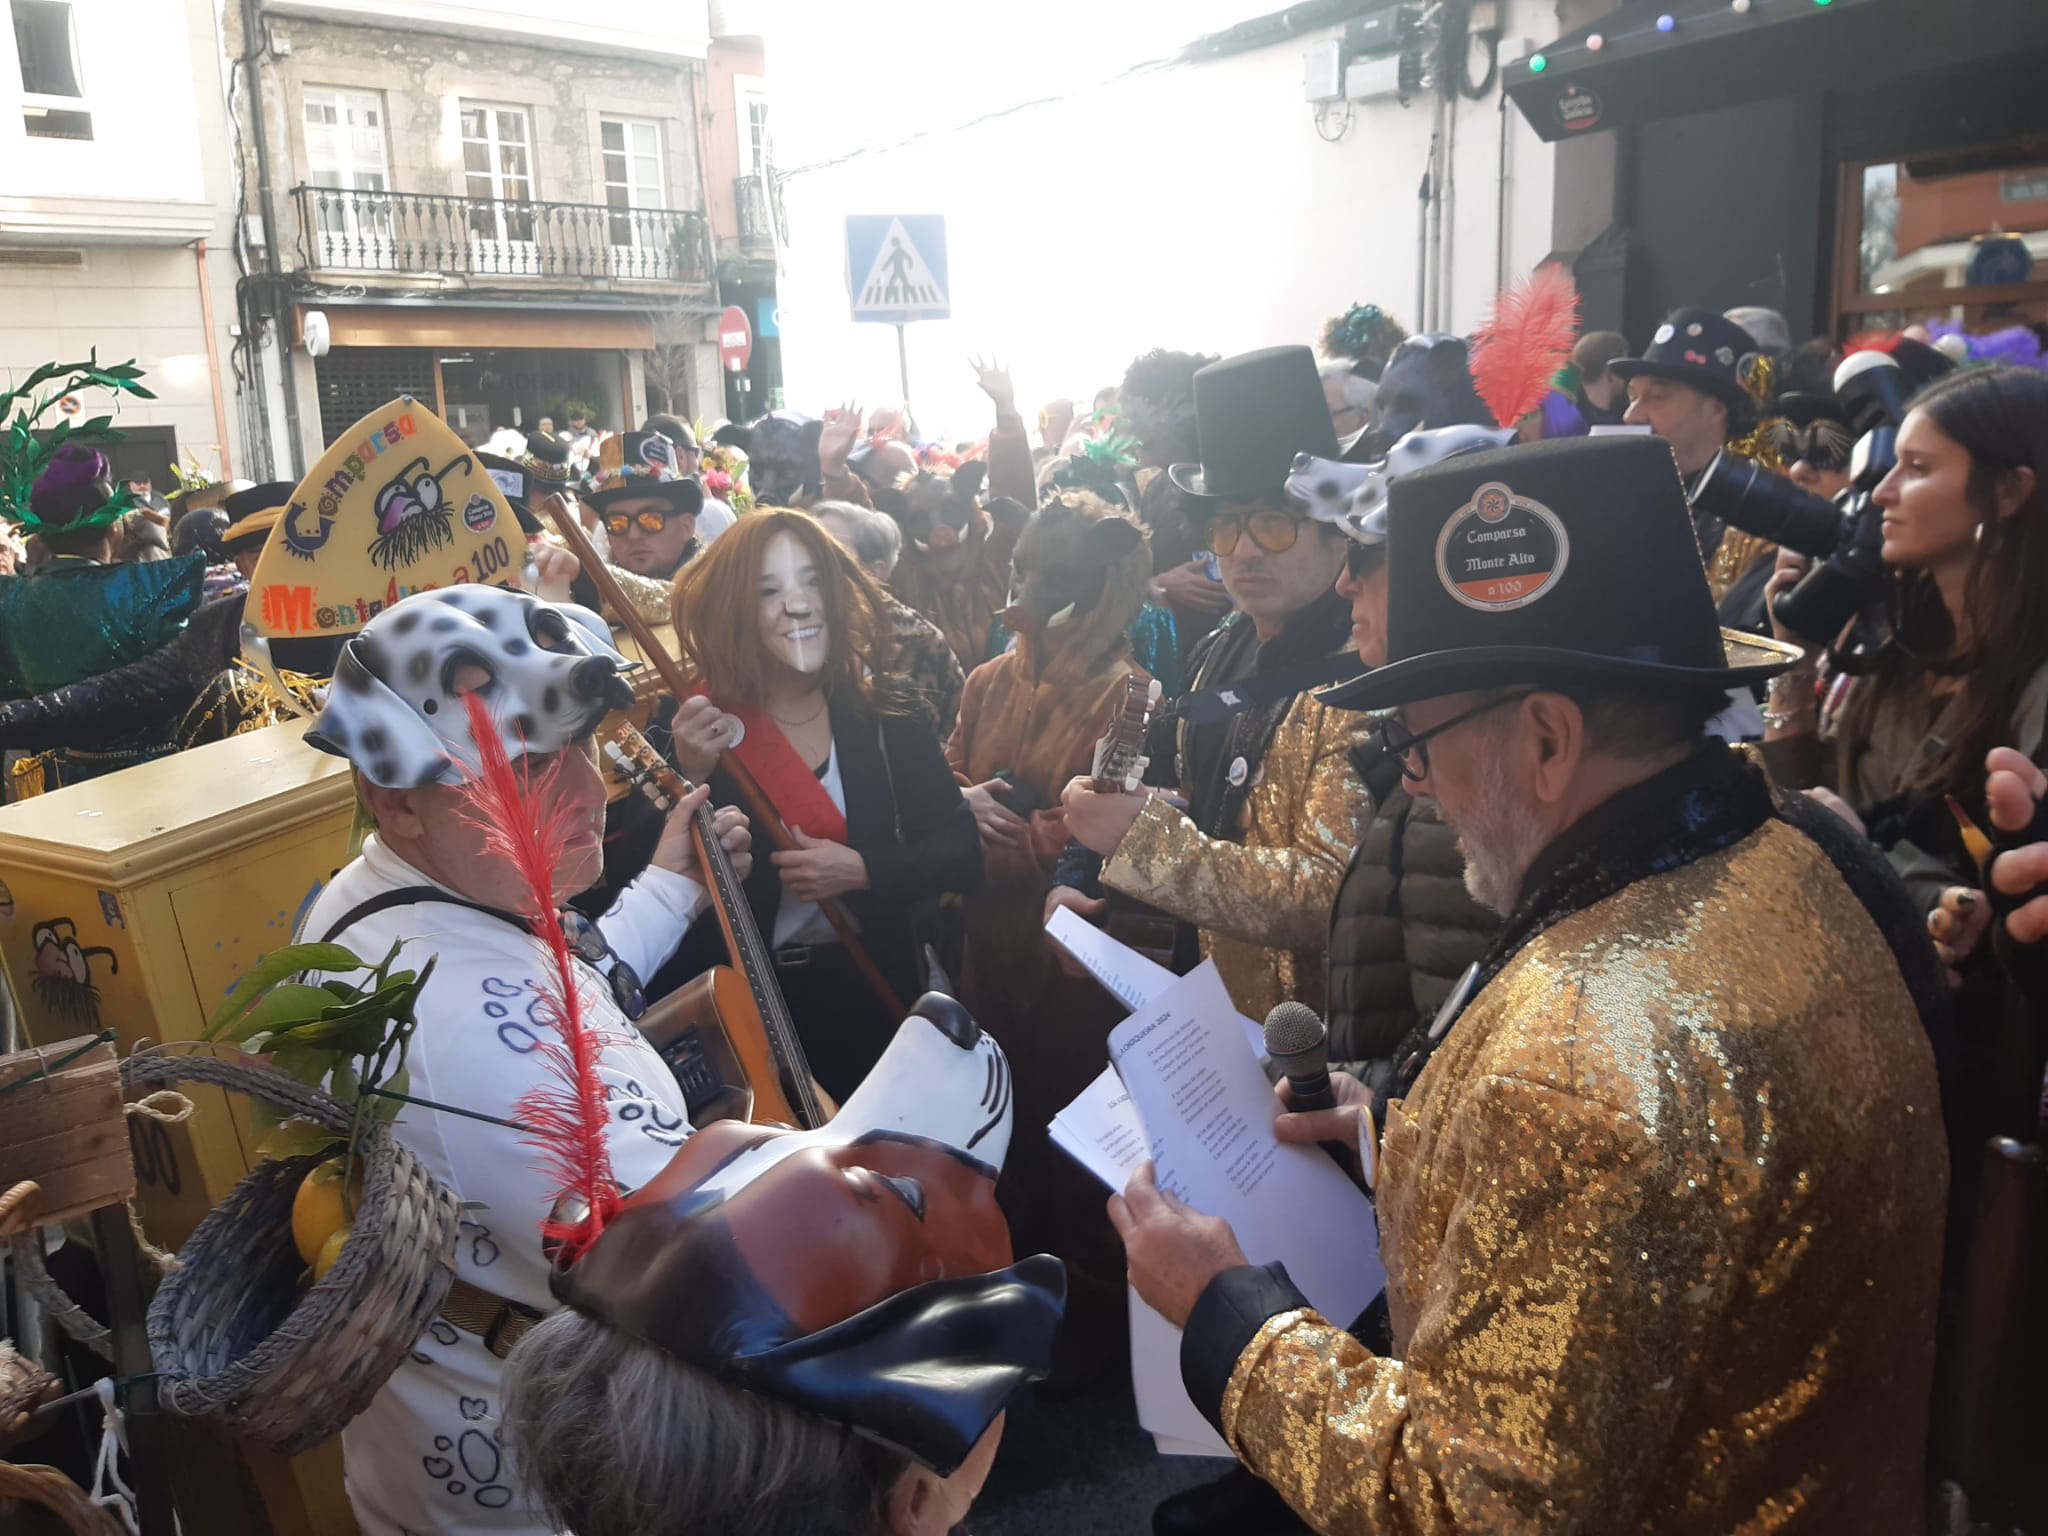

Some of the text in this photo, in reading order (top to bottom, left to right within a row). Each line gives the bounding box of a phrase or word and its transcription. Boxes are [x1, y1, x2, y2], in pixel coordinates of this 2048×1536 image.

[280, 412, 417, 562] Comparsa
[1467, 527, 1527, 544] Comparsa
[471, 536, 509, 583] 100
[1465, 553, 1535, 572] Monte Alto
[1488, 580, 1523, 595] a 100
